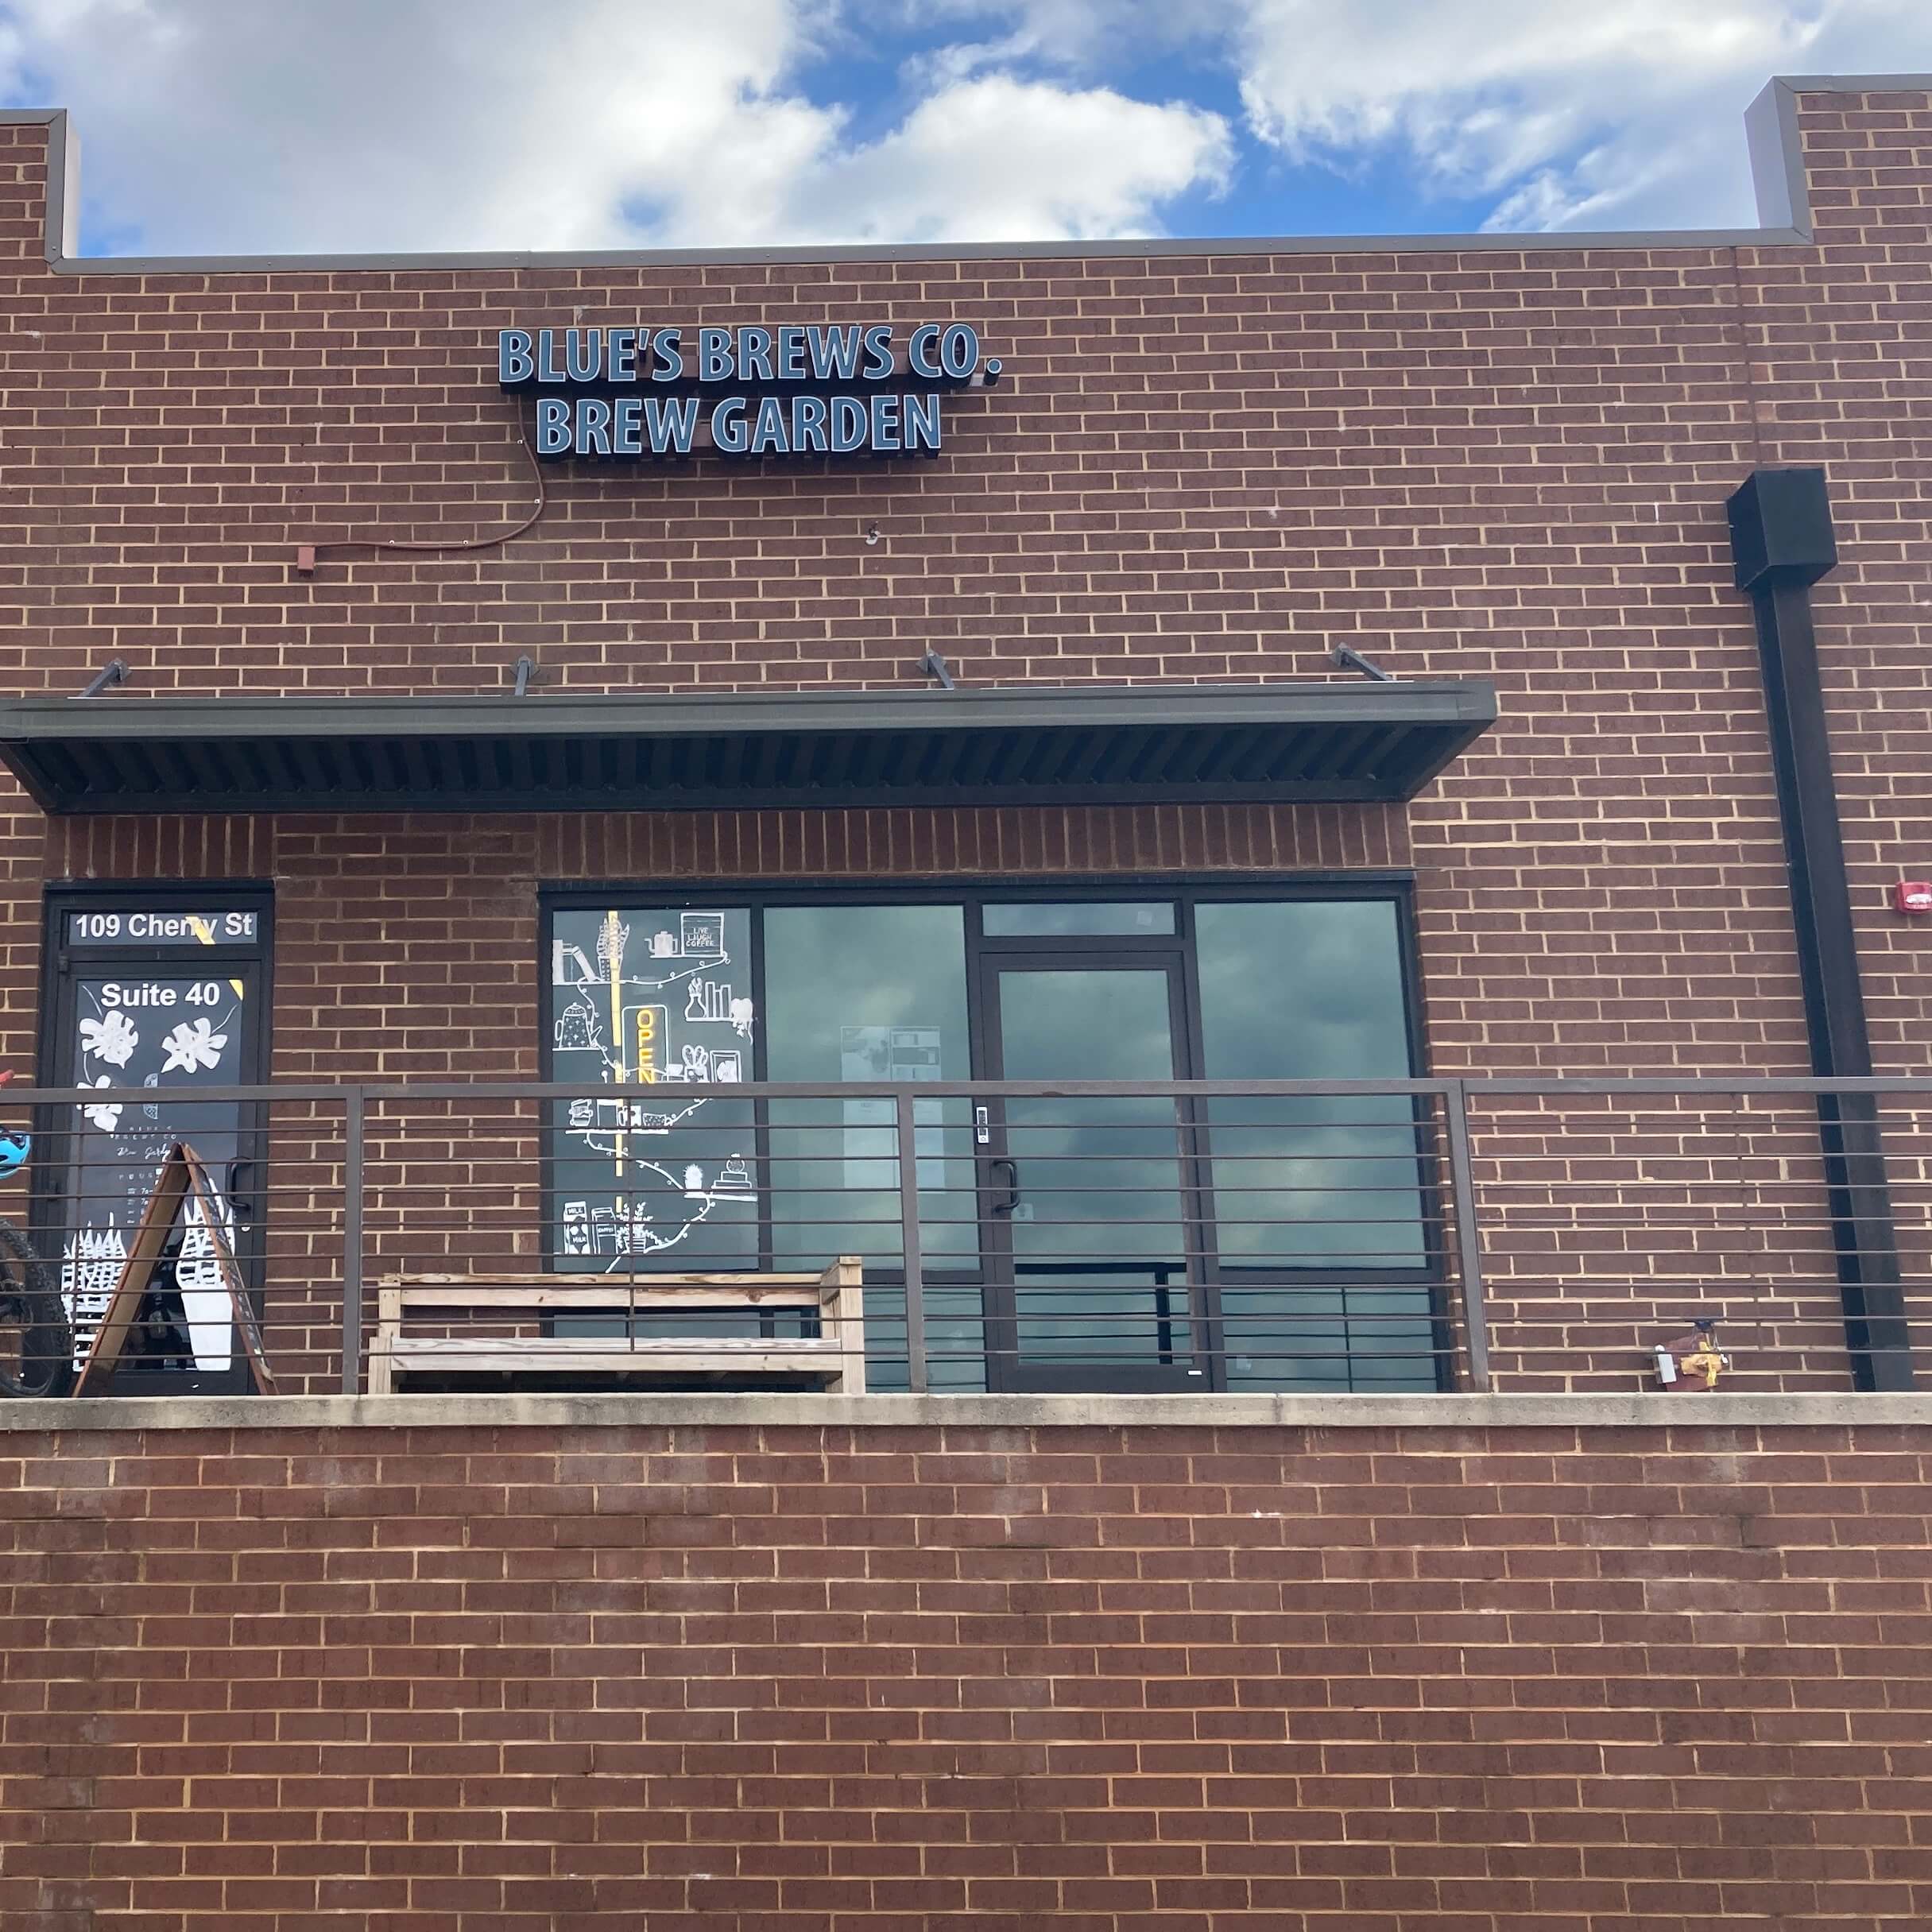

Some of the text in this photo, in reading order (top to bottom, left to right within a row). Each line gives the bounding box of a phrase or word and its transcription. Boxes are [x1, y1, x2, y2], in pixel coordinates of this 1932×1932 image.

[498, 323, 1003, 383] BLUE'S BREWS CO.
[536, 393, 943, 455] BREW GARDEN
[76, 914, 121, 938] 109
[224, 912, 253, 936] St
[100, 982, 220, 1007] Suite 40
[637, 1009, 655, 1084] OPEN
